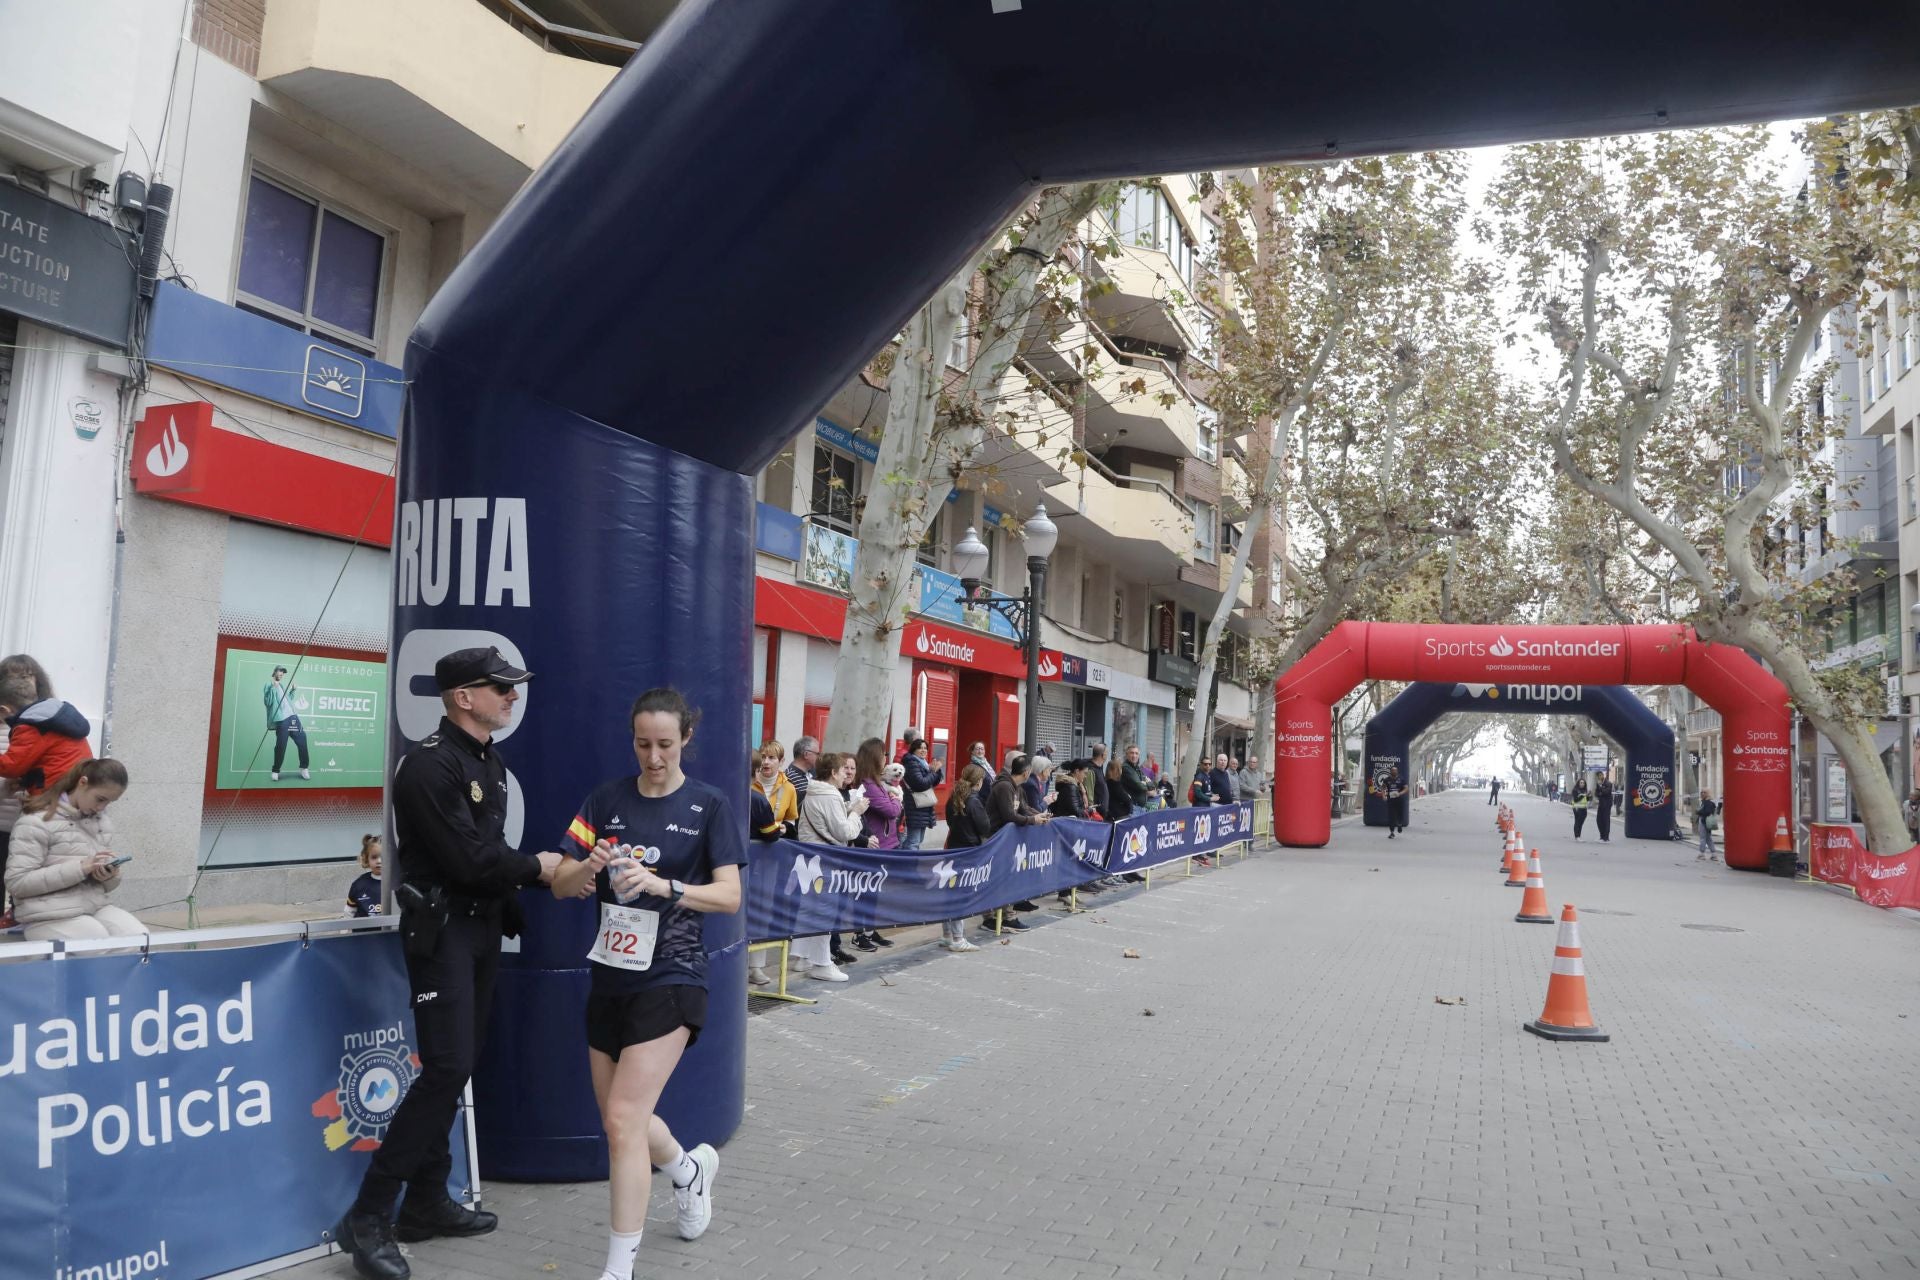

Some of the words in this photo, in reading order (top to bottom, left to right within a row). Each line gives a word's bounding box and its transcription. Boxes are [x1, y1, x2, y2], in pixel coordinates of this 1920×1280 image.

[398, 497, 531, 608] RUTA
[930, 634, 975, 663] Santander
[1425, 638, 1485, 659] Sports
[1517, 640, 1620, 657] Santander
[303, 663, 373, 677] BIENESTANDO
[1485, 663, 1551, 672] sportssantander.es
[1507, 684, 1582, 705] mupol
[318, 696, 371, 712] SMUSIC
[1287, 720, 1314, 730] Sports
[1285, 733, 1325, 742] Santander
[1747, 730, 1778, 741] Sports
[1636, 764, 1669, 773] fundación
[1641, 772, 1663, 780] mupol
[680, 827, 700, 836] mupol
[1194, 813, 1212, 845] 200
[1157, 833, 1185, 850] NACIONAL
[828, 864, 888, 900] mupol
[959, 856, 993, 892] mupol
[1028, 842, 1052, 873] mupol
[604, 929, 638, 955] 122
[417, 992, 438, 1003] CNP
[0, 980, 253, 1077] ualidad
[344, 1021, 405, 1050] mupol
[38, 1066, 272, 1169] Policía
